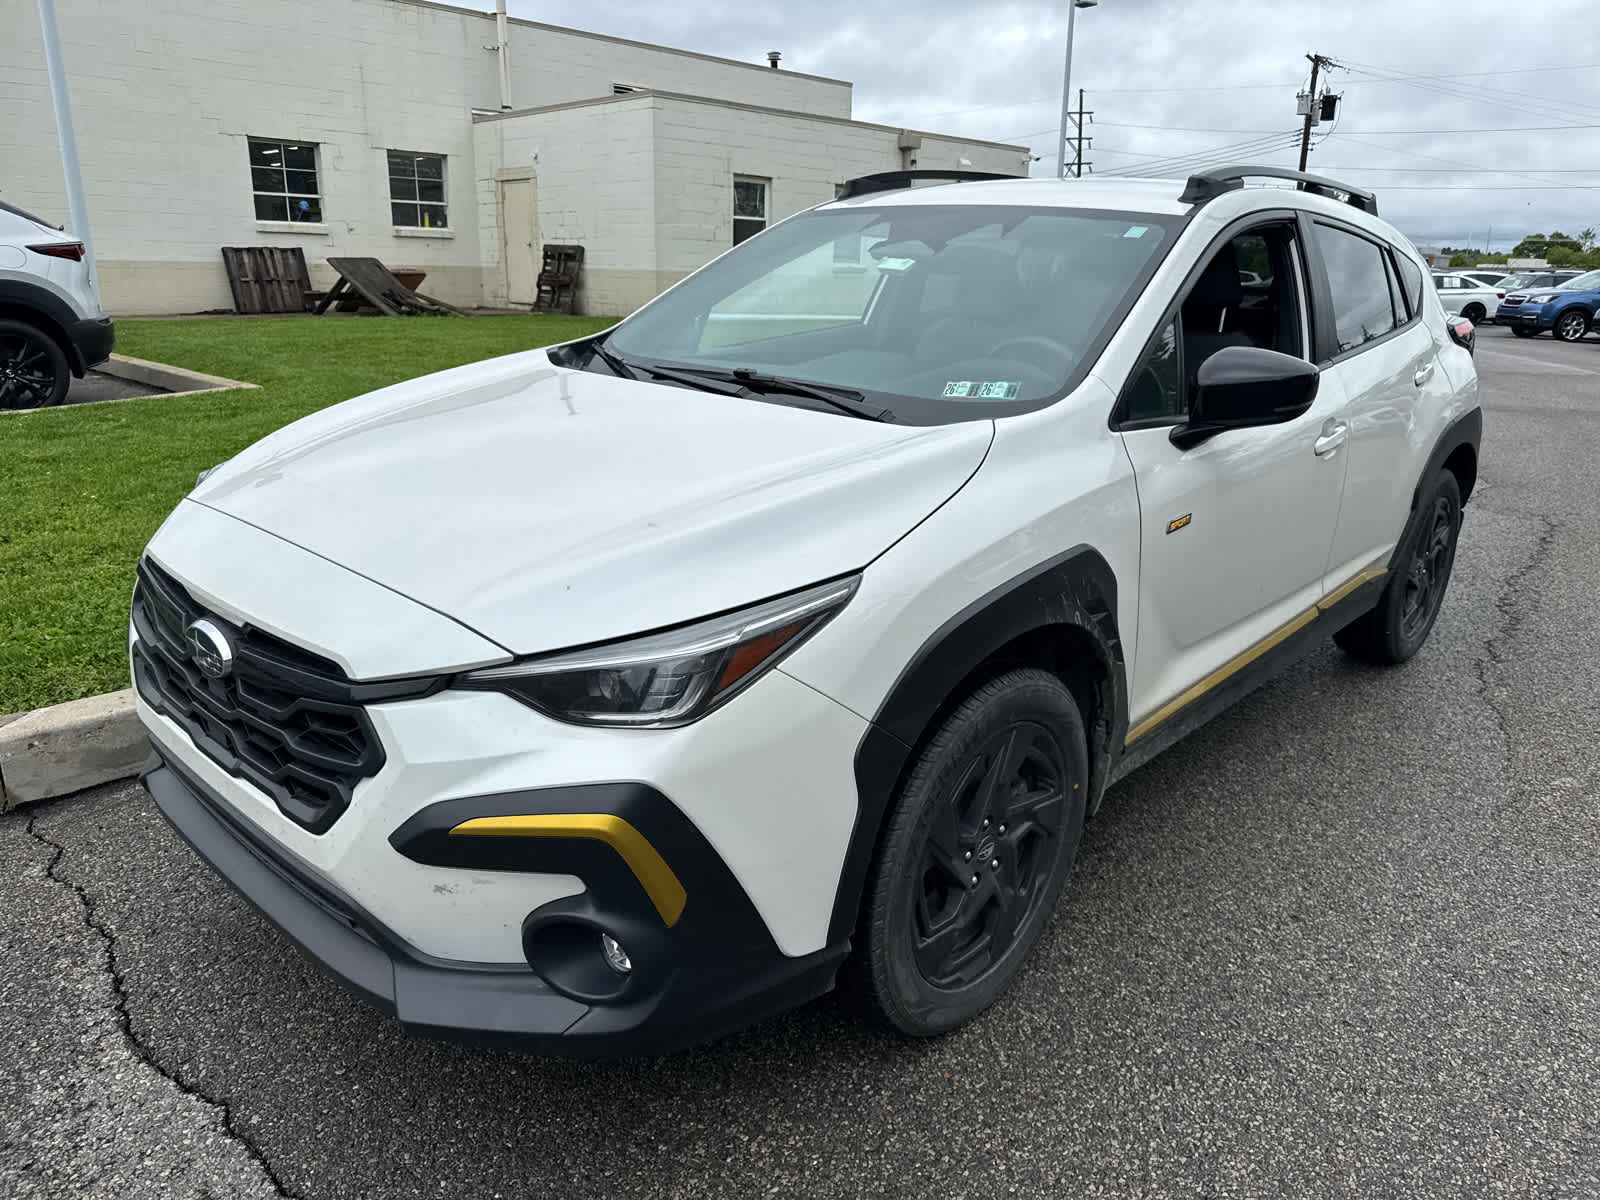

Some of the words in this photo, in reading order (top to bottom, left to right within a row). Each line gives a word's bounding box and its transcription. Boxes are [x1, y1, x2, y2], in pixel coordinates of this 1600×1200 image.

[944, 383, 957, 395] 26
[981, 383, 994, 395] 26
[1169, 514, 1191, 531] SPORT
